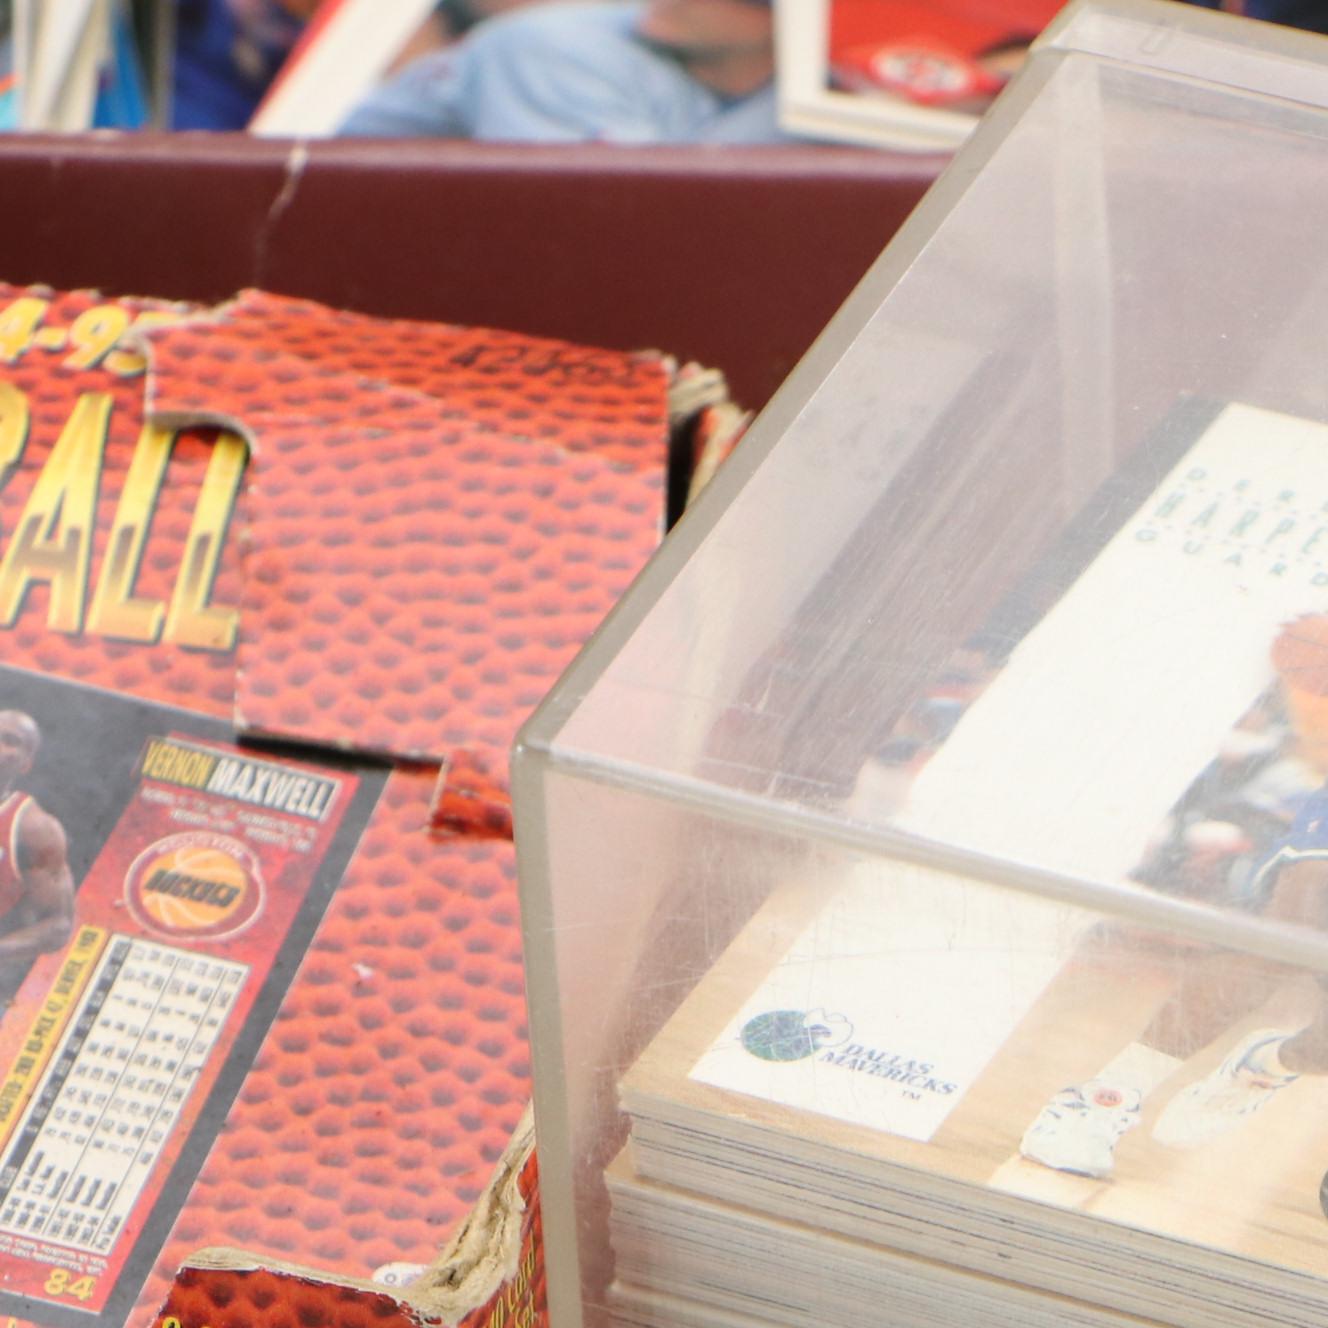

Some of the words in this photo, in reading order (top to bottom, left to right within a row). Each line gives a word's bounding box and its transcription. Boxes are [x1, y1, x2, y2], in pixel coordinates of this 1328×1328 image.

[141, 740, 215, 789] VERNON
[206, 757, 334, 820] MAXWELL
[818, 1050, 959, 1096] MAVERICKS
[843, 1043, 935, 1076] DALLAS
[43, 1267, 97, 1301] 84
